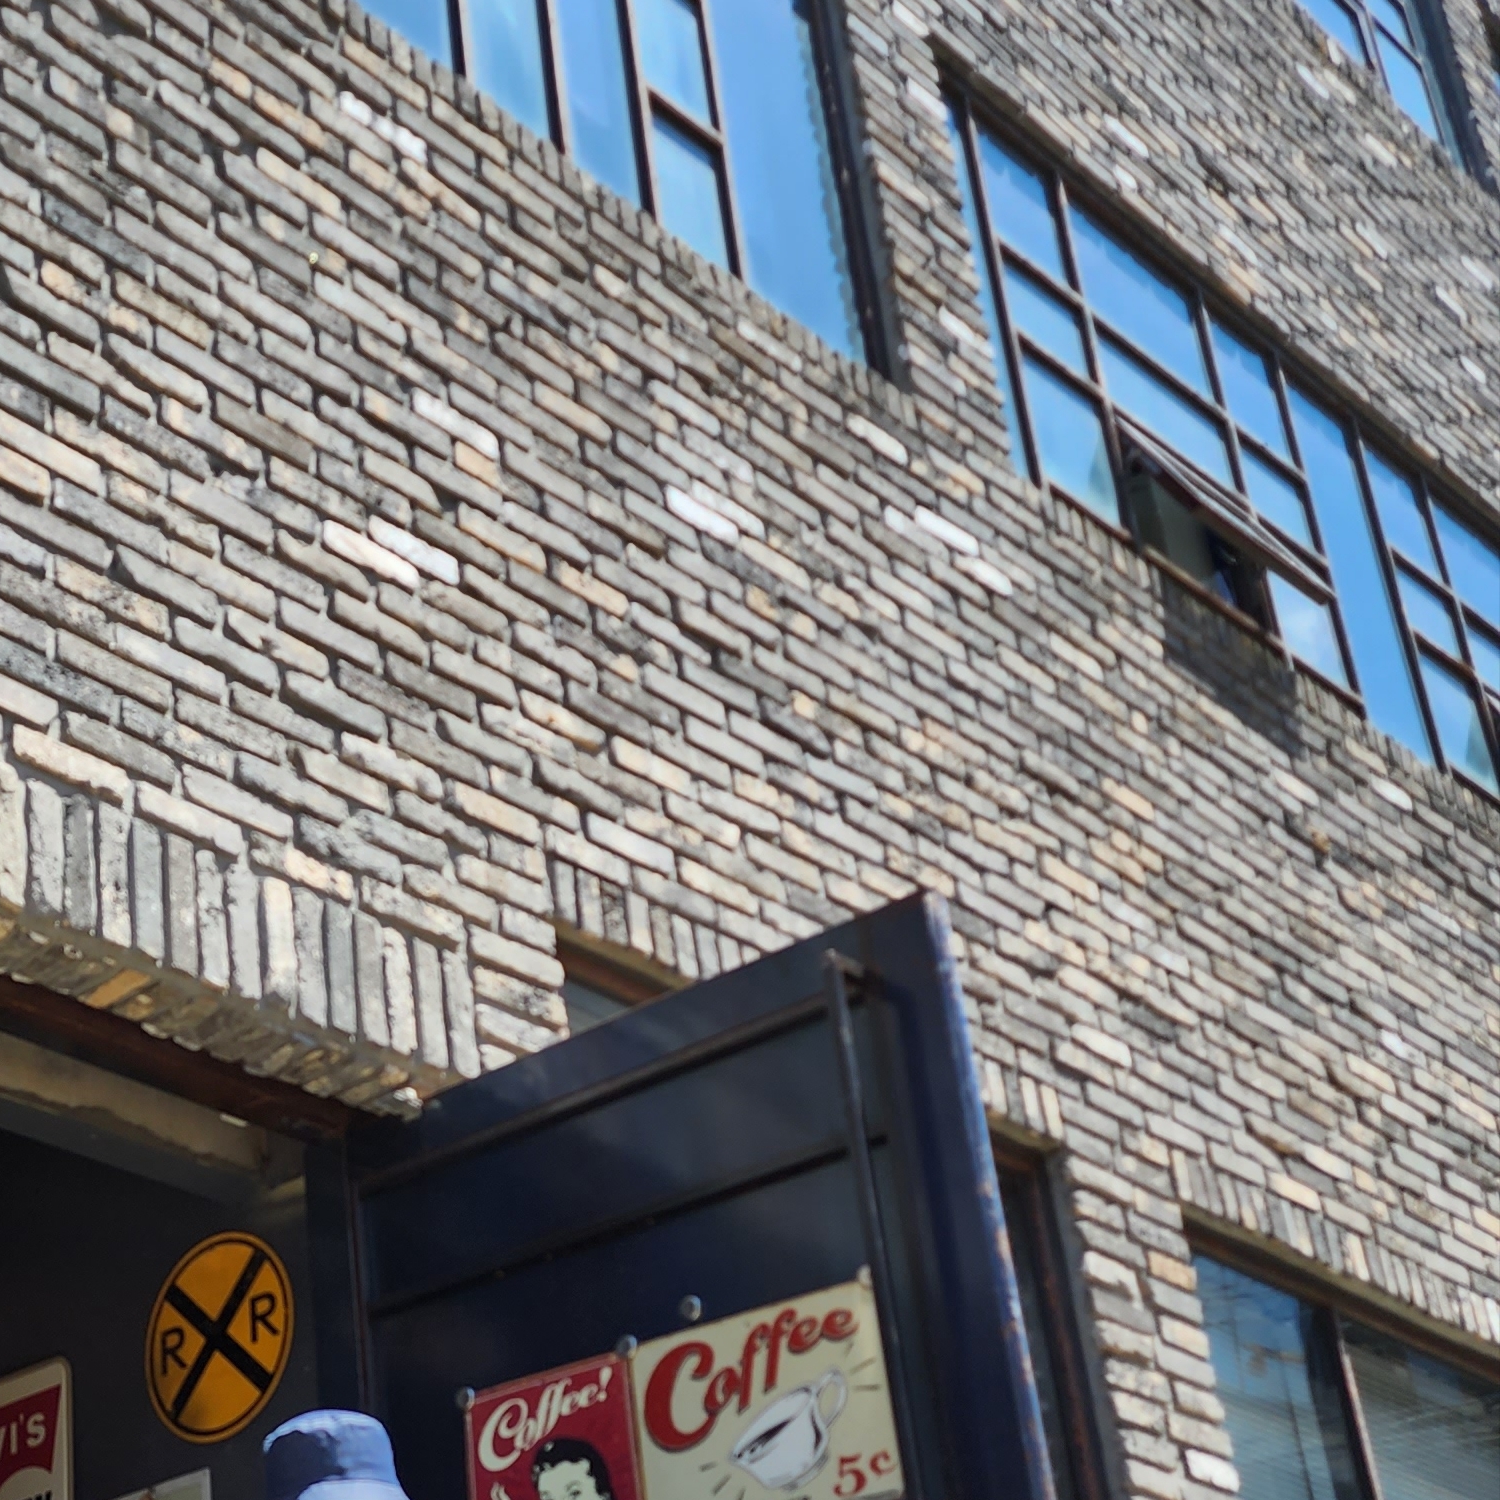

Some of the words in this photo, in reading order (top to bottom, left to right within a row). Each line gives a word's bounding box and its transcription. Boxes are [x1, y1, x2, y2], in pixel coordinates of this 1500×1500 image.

[161, 1327, 188, 1376] R
[249, 1291, 281, 1345] R
[644, 1307, 860, 1453] Coffee
[478, 1366, 613, 1473] Coffee!
